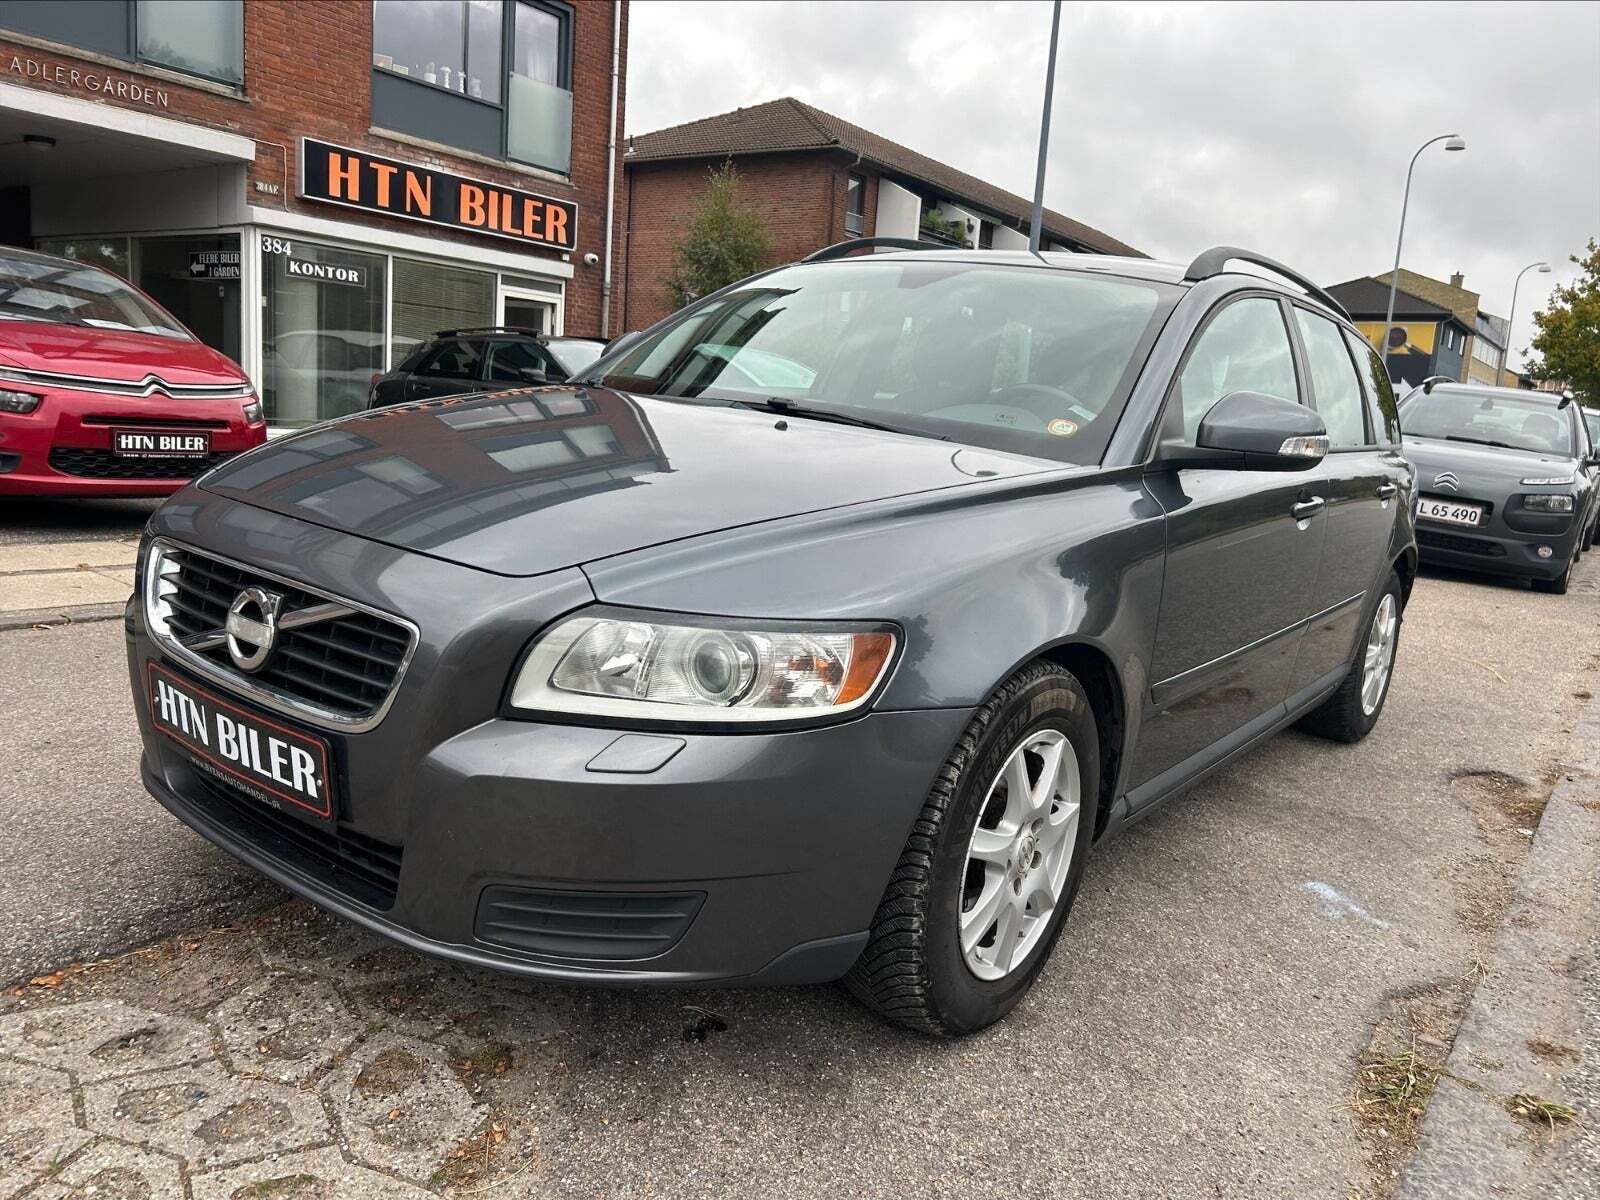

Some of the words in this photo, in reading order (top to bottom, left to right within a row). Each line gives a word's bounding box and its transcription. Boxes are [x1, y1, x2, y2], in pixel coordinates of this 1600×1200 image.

[10, 56, 169, 107] ADLERGÅRDEN
[328, 152, 432, 217] HTN
[459, 183, 568, 244] BILER
[262, 237, 292, 256] 384
[220, 253, 240, 264] BILER
[289, 260, 359, 282] KONTOR
[120, 435, 154, 449] HTN
[160, 436, 204, 450] BILER
[1431, 505, 1448, 517] 65
[1452, 508, 1478, 522] 490
[157, 679, 209, 747] HTN
[216, 712, 318, 799] BILER
